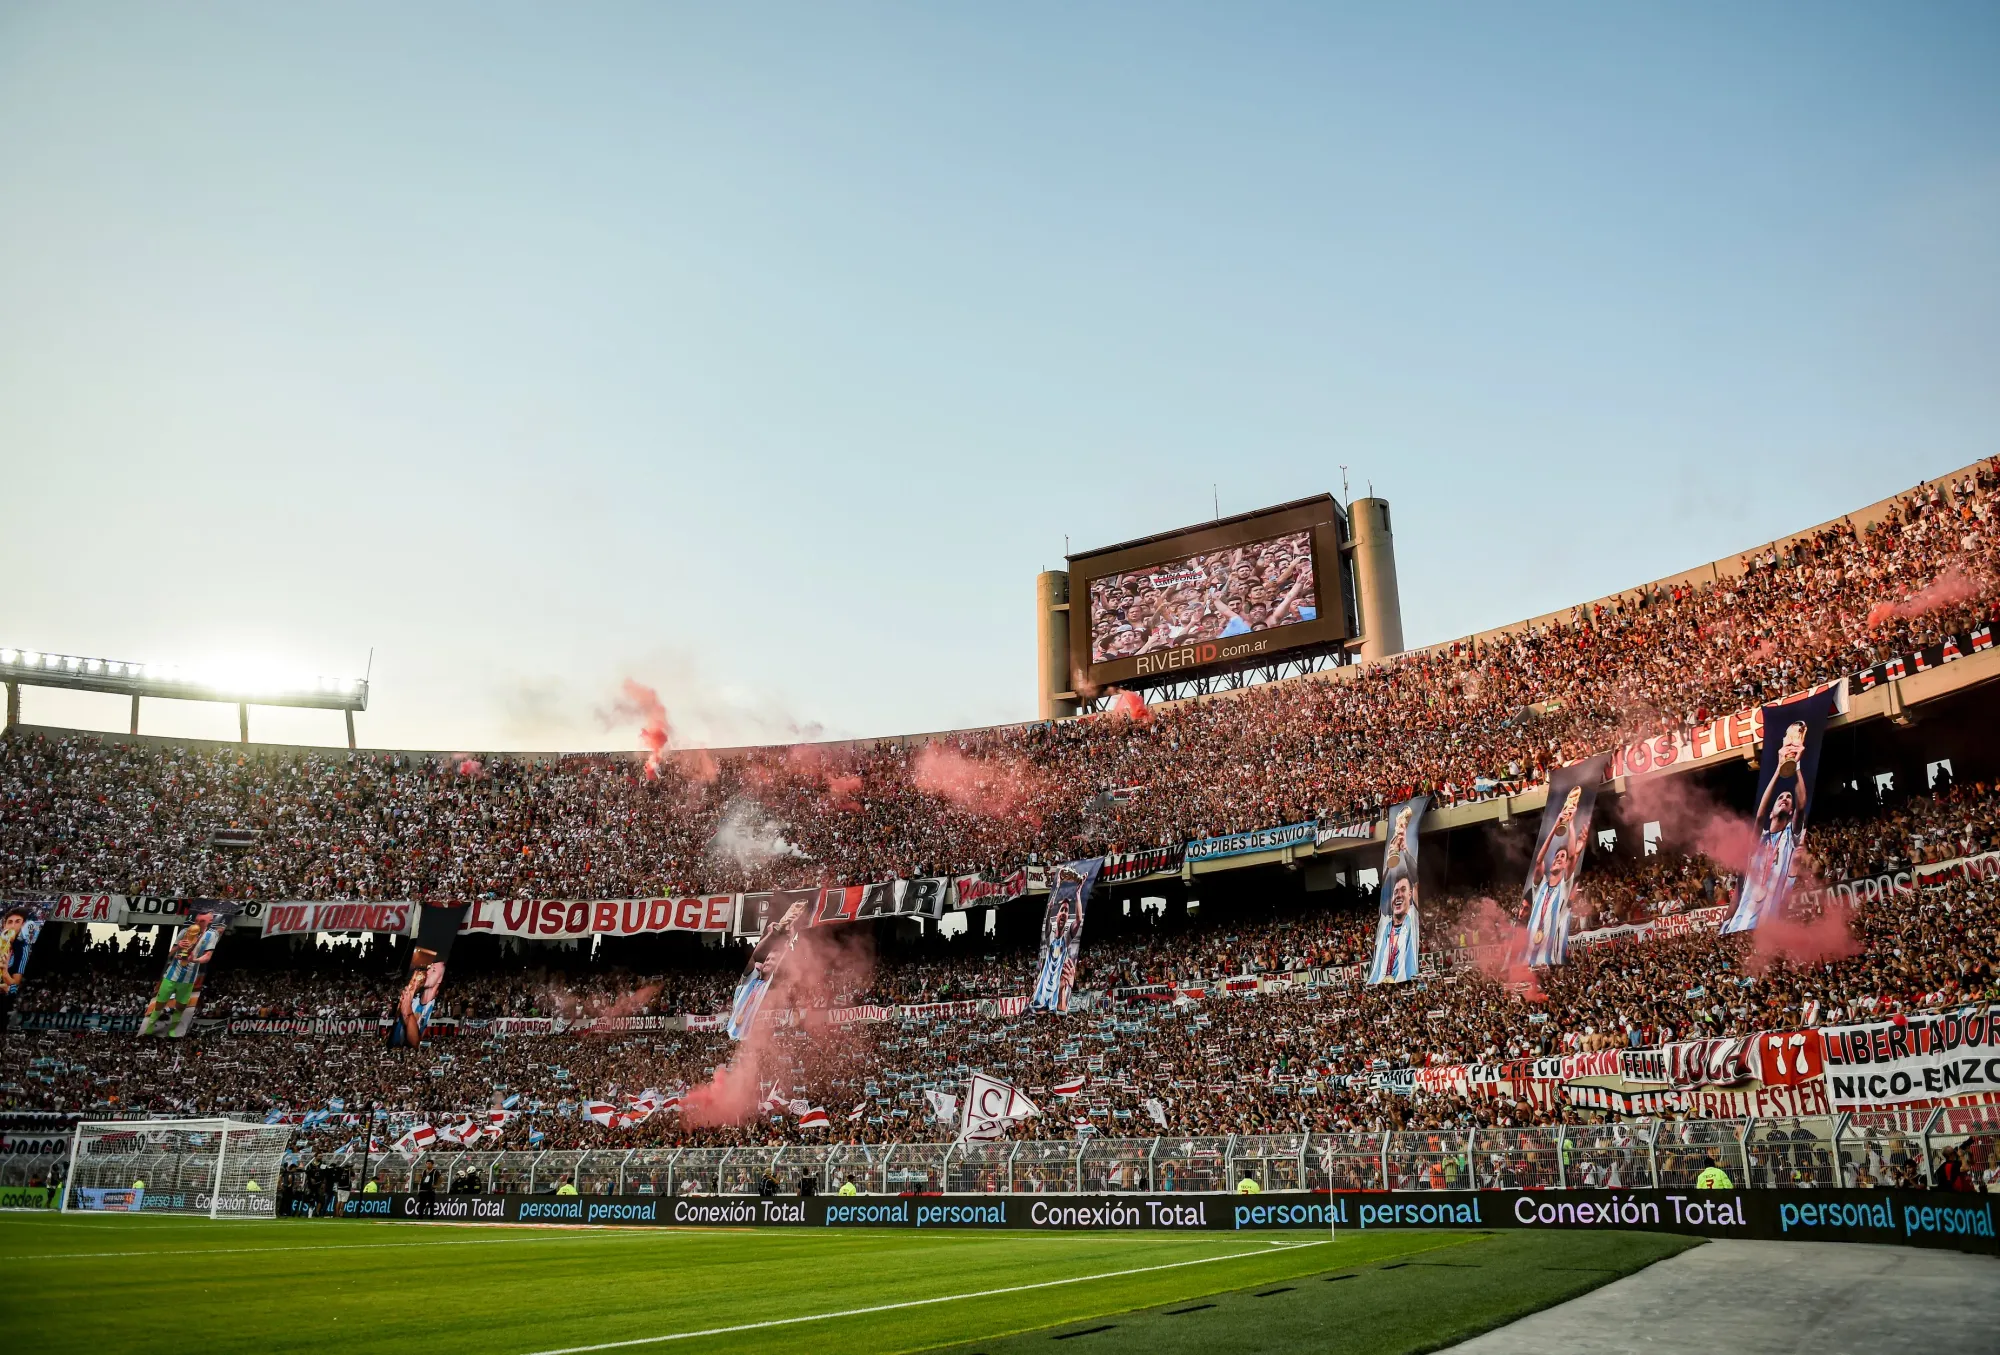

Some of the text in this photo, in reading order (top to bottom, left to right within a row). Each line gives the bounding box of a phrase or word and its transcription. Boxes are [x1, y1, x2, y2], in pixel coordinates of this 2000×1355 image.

[1187, 826, 1305, 858] LOS PIBES DE SAVIO
[265, 903, 409, 933] POLVORINES
[503, 899, 590, 934] VISO
[592, 896, 730, 933] BUDGE
[741, 880, 940, 935] PLAR
[506, 1019, 550, 1035] DORREGO
[1562, 1049, 1621, 1080] GARIN
[1769, 1034, 1808, 1075] 77
[1562, 1086, 1627, 1115] VILLA
[2, 1189, 43, 1208] codere
[141, 1193, 185, 1208] persoal
[195, 1193, 245, 1210] Coexión
[248, 1194, 275, 1211] Total
[344, 1197, 392, 1213] ersonal
[472, 1199, 505, 1216] Total
[519, 1200, 805, 1222] personal personal Conexión Total
[826, 1200, 1207, 1227] personal personal Conexión Total
[1235, 1195, 1995, 1237] personal personal Conexión Total personal personal
